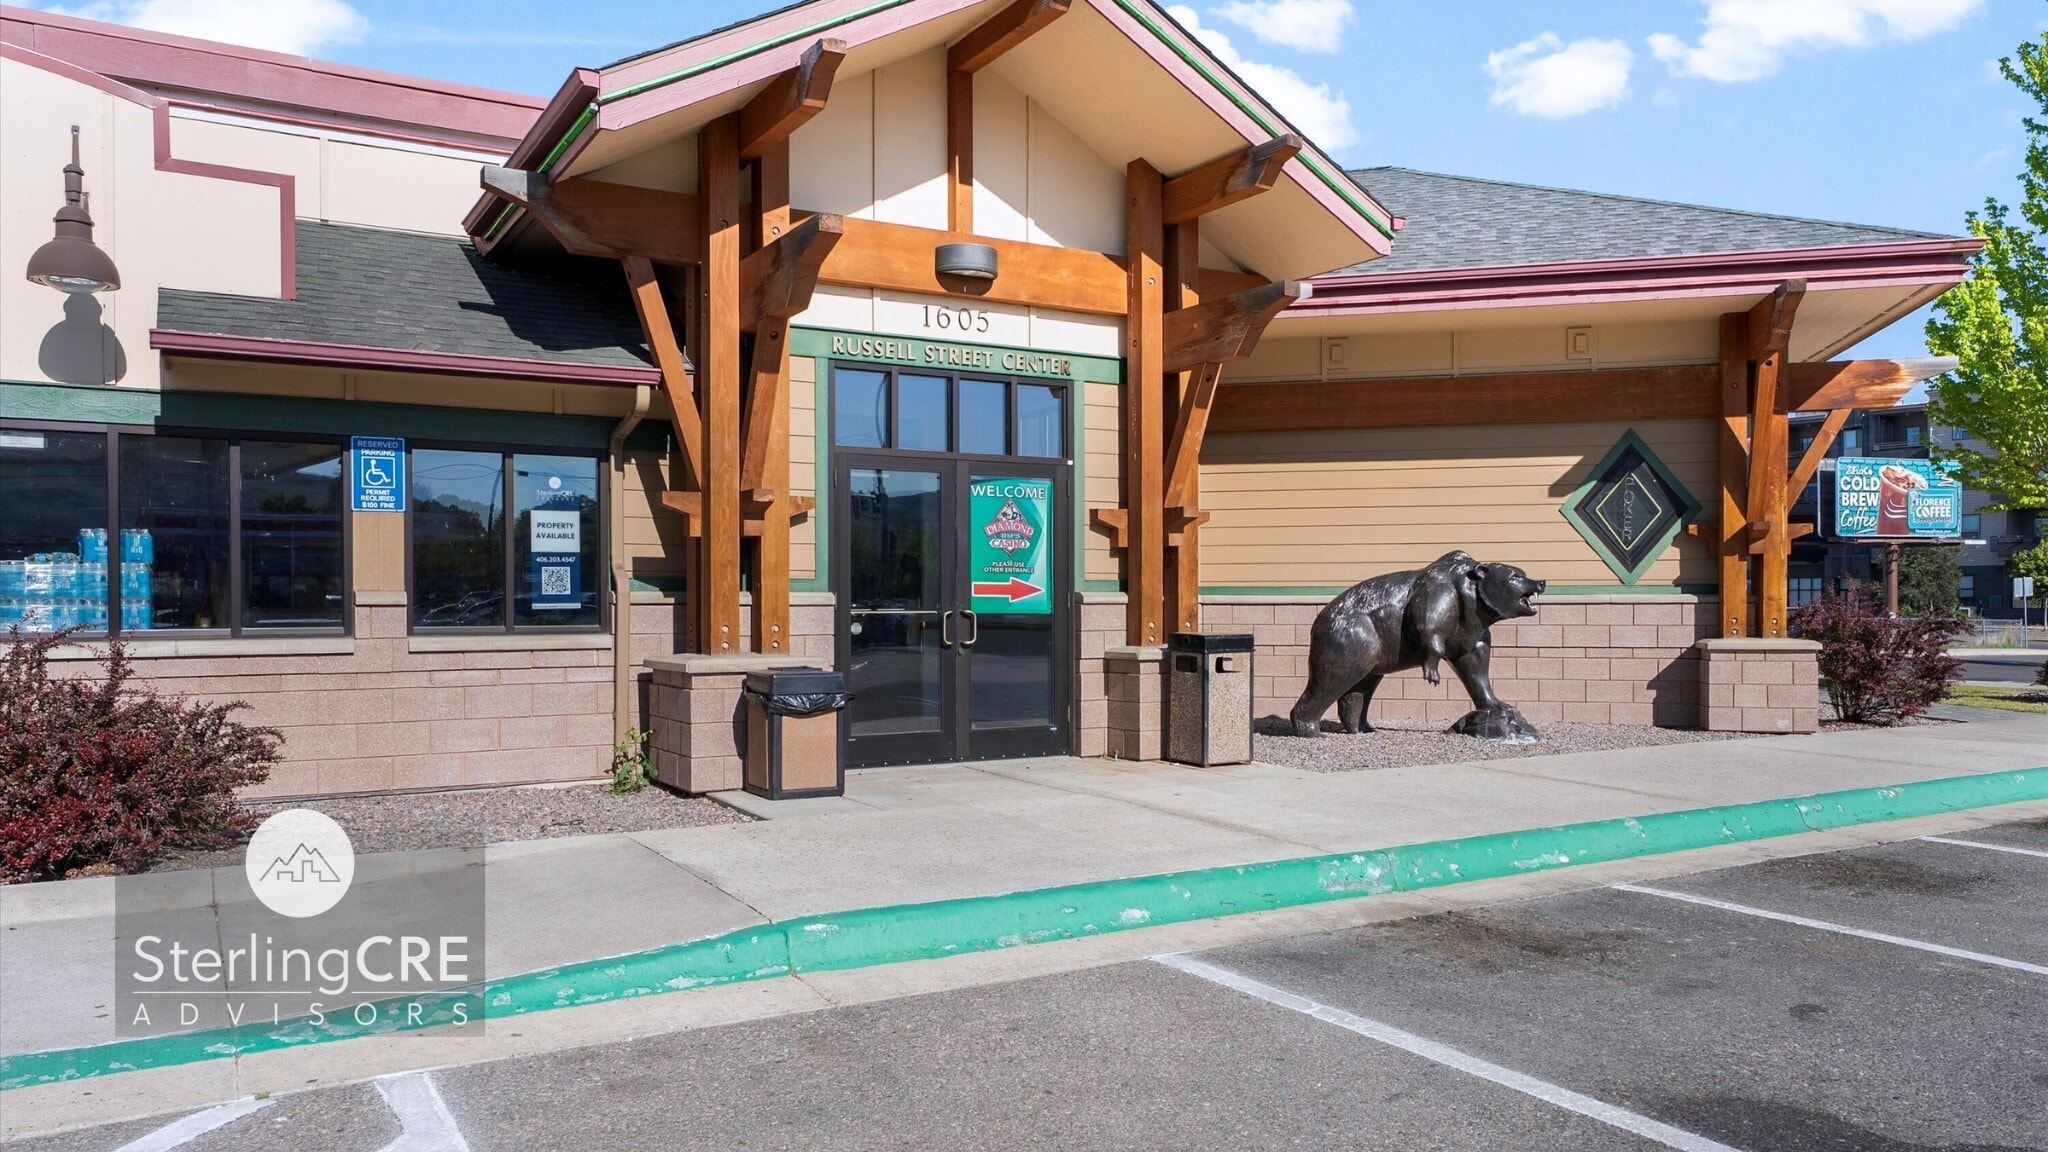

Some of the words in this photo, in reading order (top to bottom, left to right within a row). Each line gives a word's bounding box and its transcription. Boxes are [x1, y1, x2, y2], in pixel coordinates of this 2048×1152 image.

[922, 305, 990, 333] 1605
[832, 335, 917, 361] RUSSELL
[924, 345, 993, 368] STREET
[1001, 353, 1072, 376] CENTER
[357, 440, 398, 449] RESERVED
[361, 449, 395, 457] PARKING
[1840, 476, 1880, 491] COLD
[970, 485, 1046, 499] WELCOME
[1842, 492, 1879, 506] BREW
[1915, 498, 1951, 506] FLORENCE
[1840, 507, 1877, 530] Coffee
[986, 522, 1035, 537] DIAMOND
[991, 540, 1028, 549] CASINO
[535, 556, 576, 564] 406.203.4547
[1005, 566, 1035, 574] ENTRANCE
